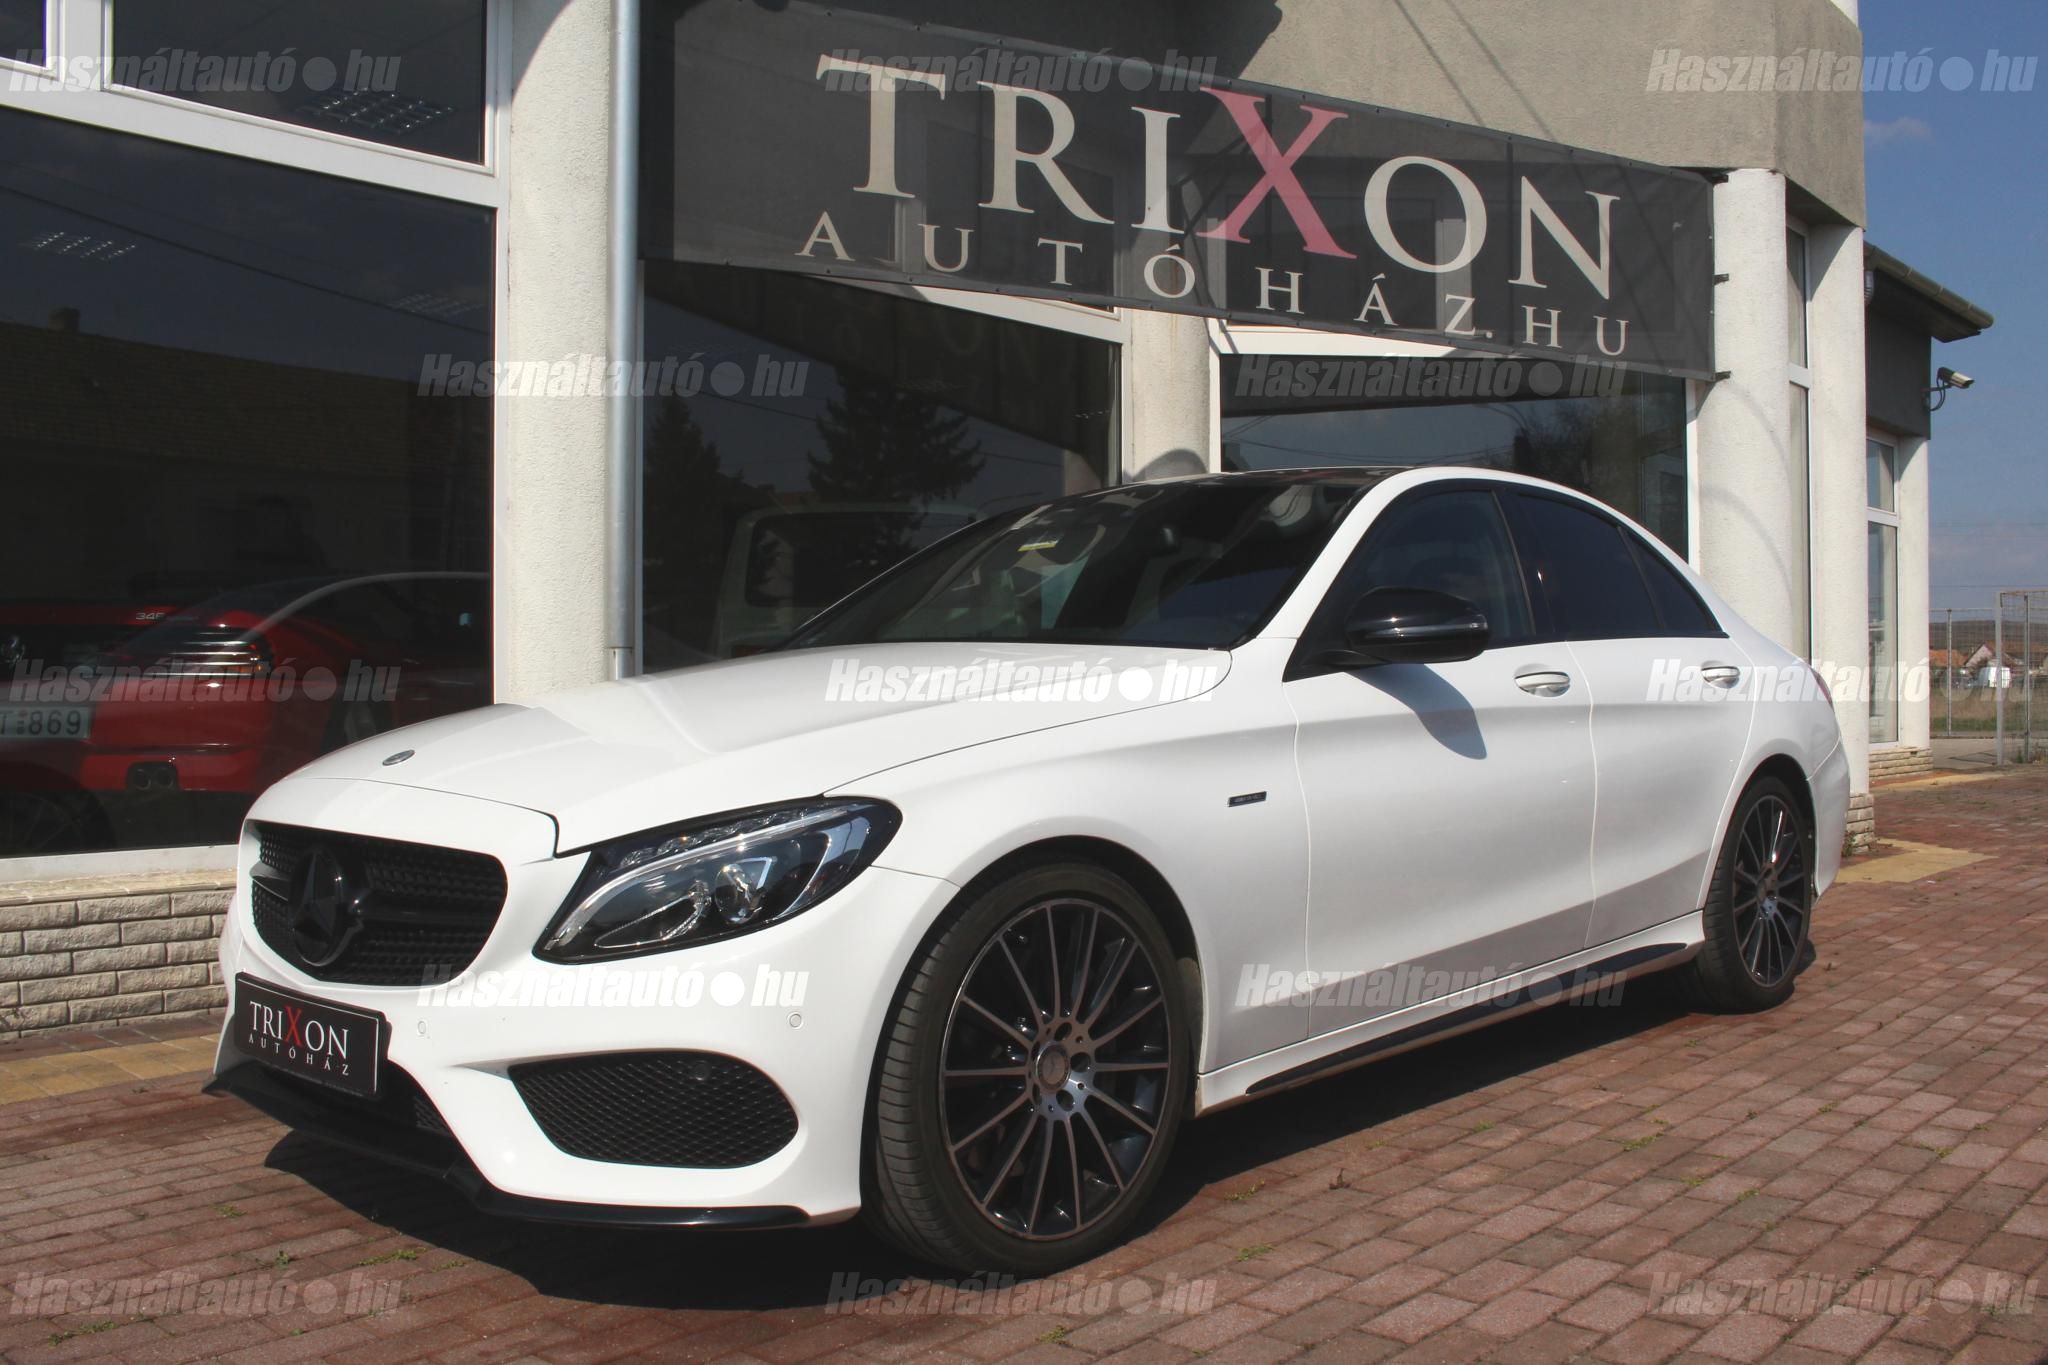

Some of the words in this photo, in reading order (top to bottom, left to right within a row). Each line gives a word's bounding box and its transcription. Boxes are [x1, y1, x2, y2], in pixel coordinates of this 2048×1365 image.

[815, 53, 1621, 301] TRIXON
[249, 1033, 349, 1076] AUTÓHÁZ
[250, 1001, 349, 1059] TRIXON
